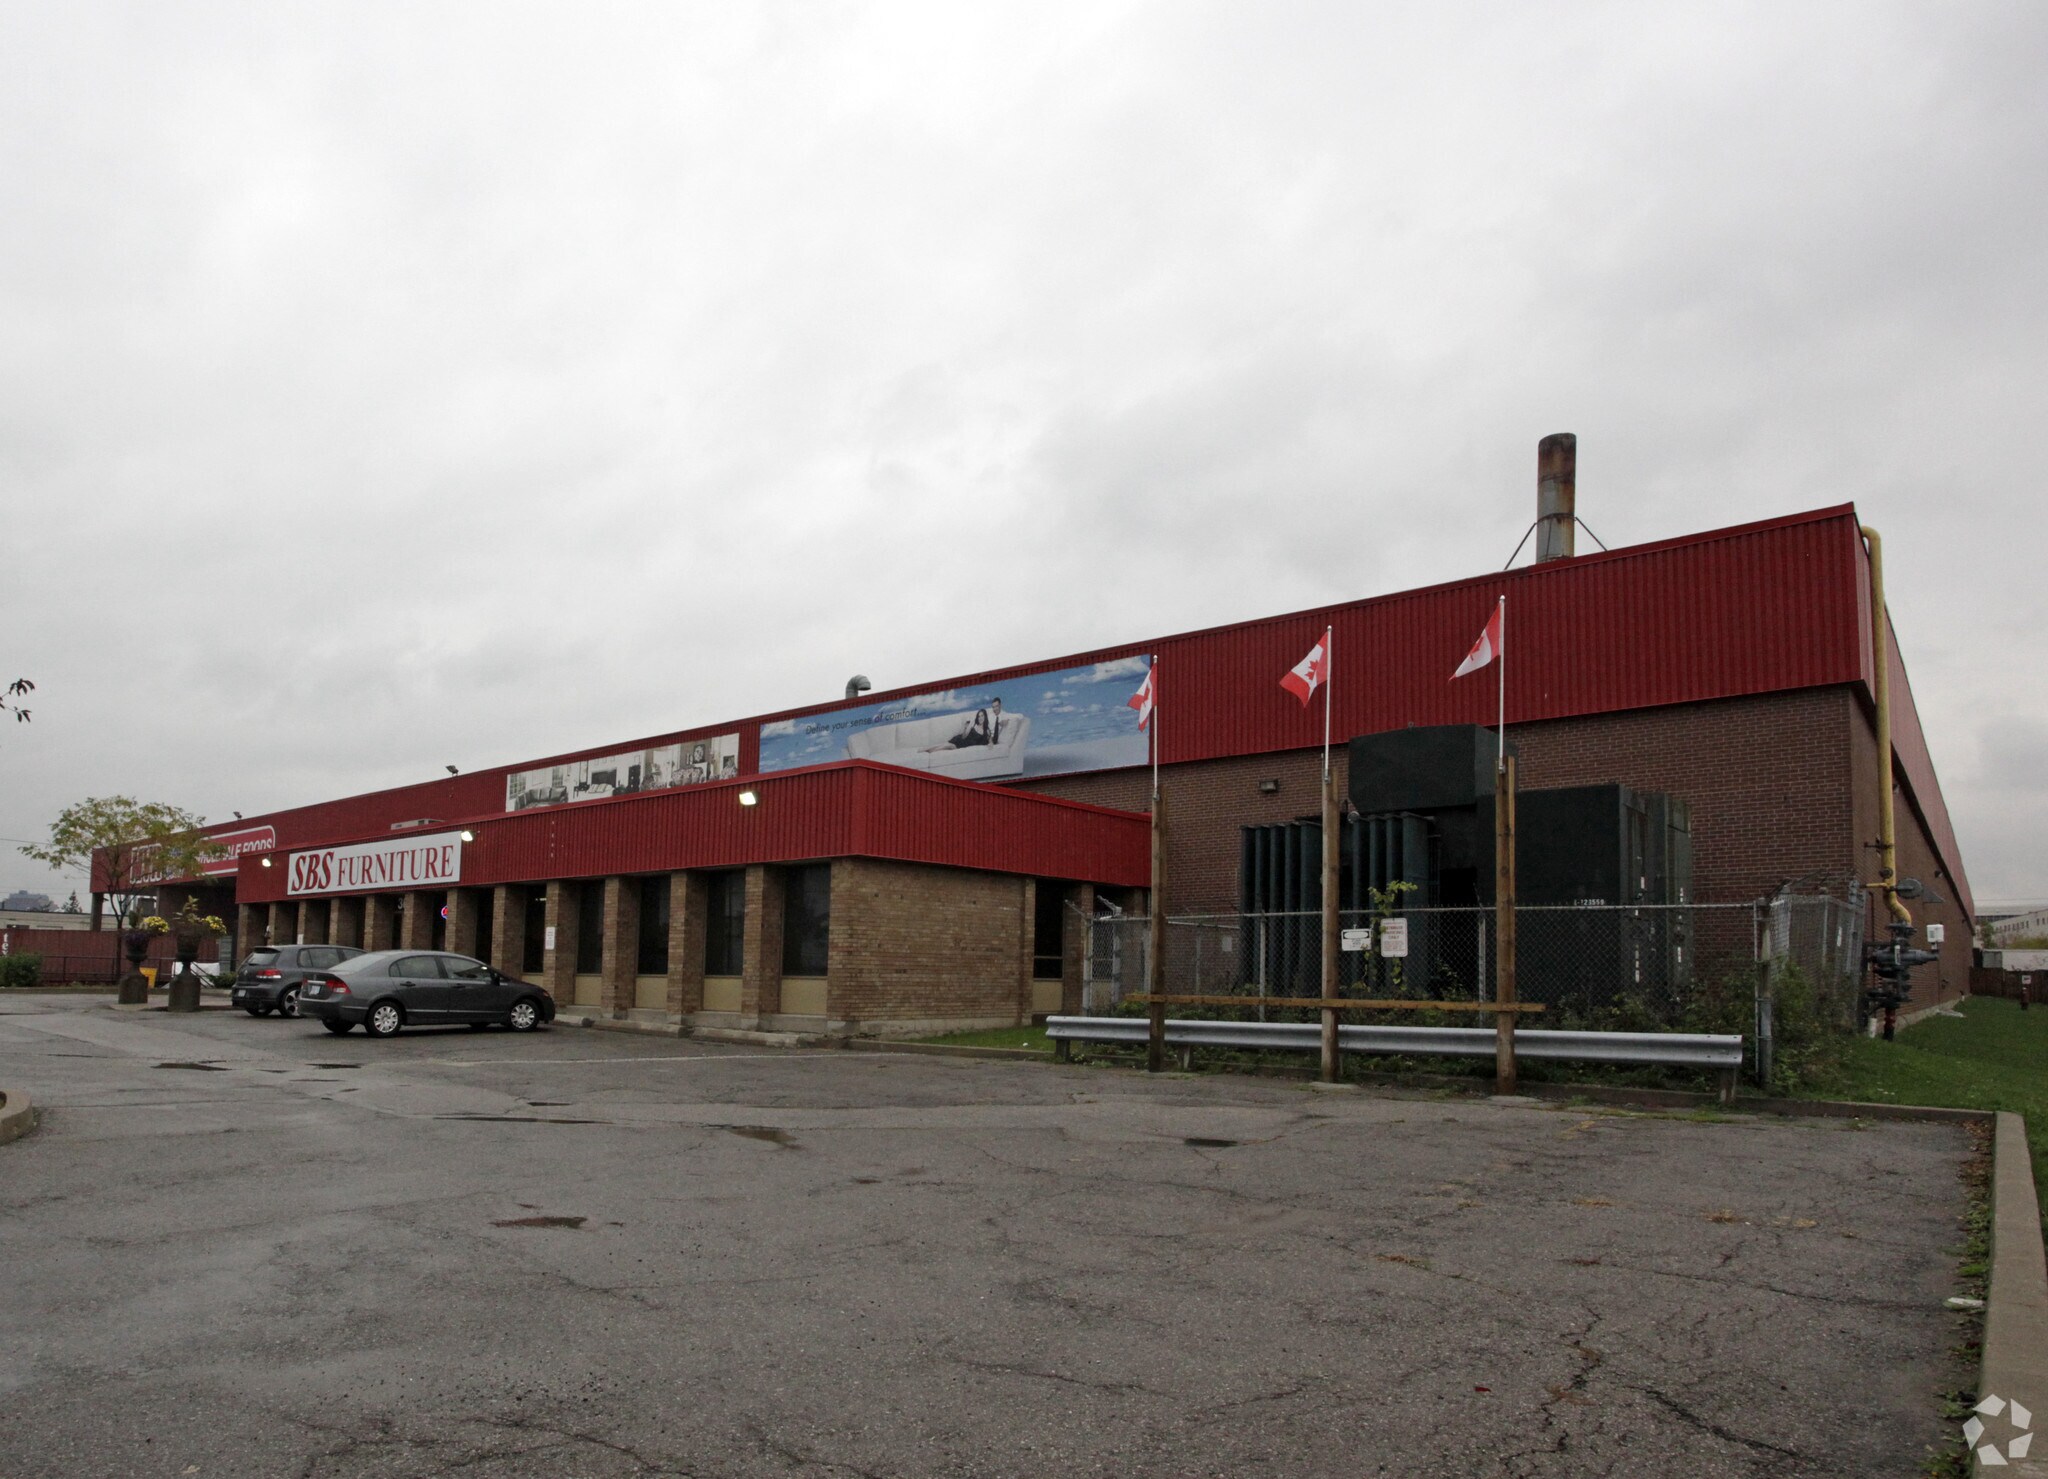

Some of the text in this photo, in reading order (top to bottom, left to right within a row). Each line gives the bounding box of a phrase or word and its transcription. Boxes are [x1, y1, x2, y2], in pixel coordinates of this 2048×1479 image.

[805, 722, 830, 735] Define
[832, 722, 848, 733] your
[850, 716, 873, 728] sense
[874, 711, 884, 723] of
[243, 838, 273, 853] FOODS
[291, 845, 454, 892] SBS FURNITURE
